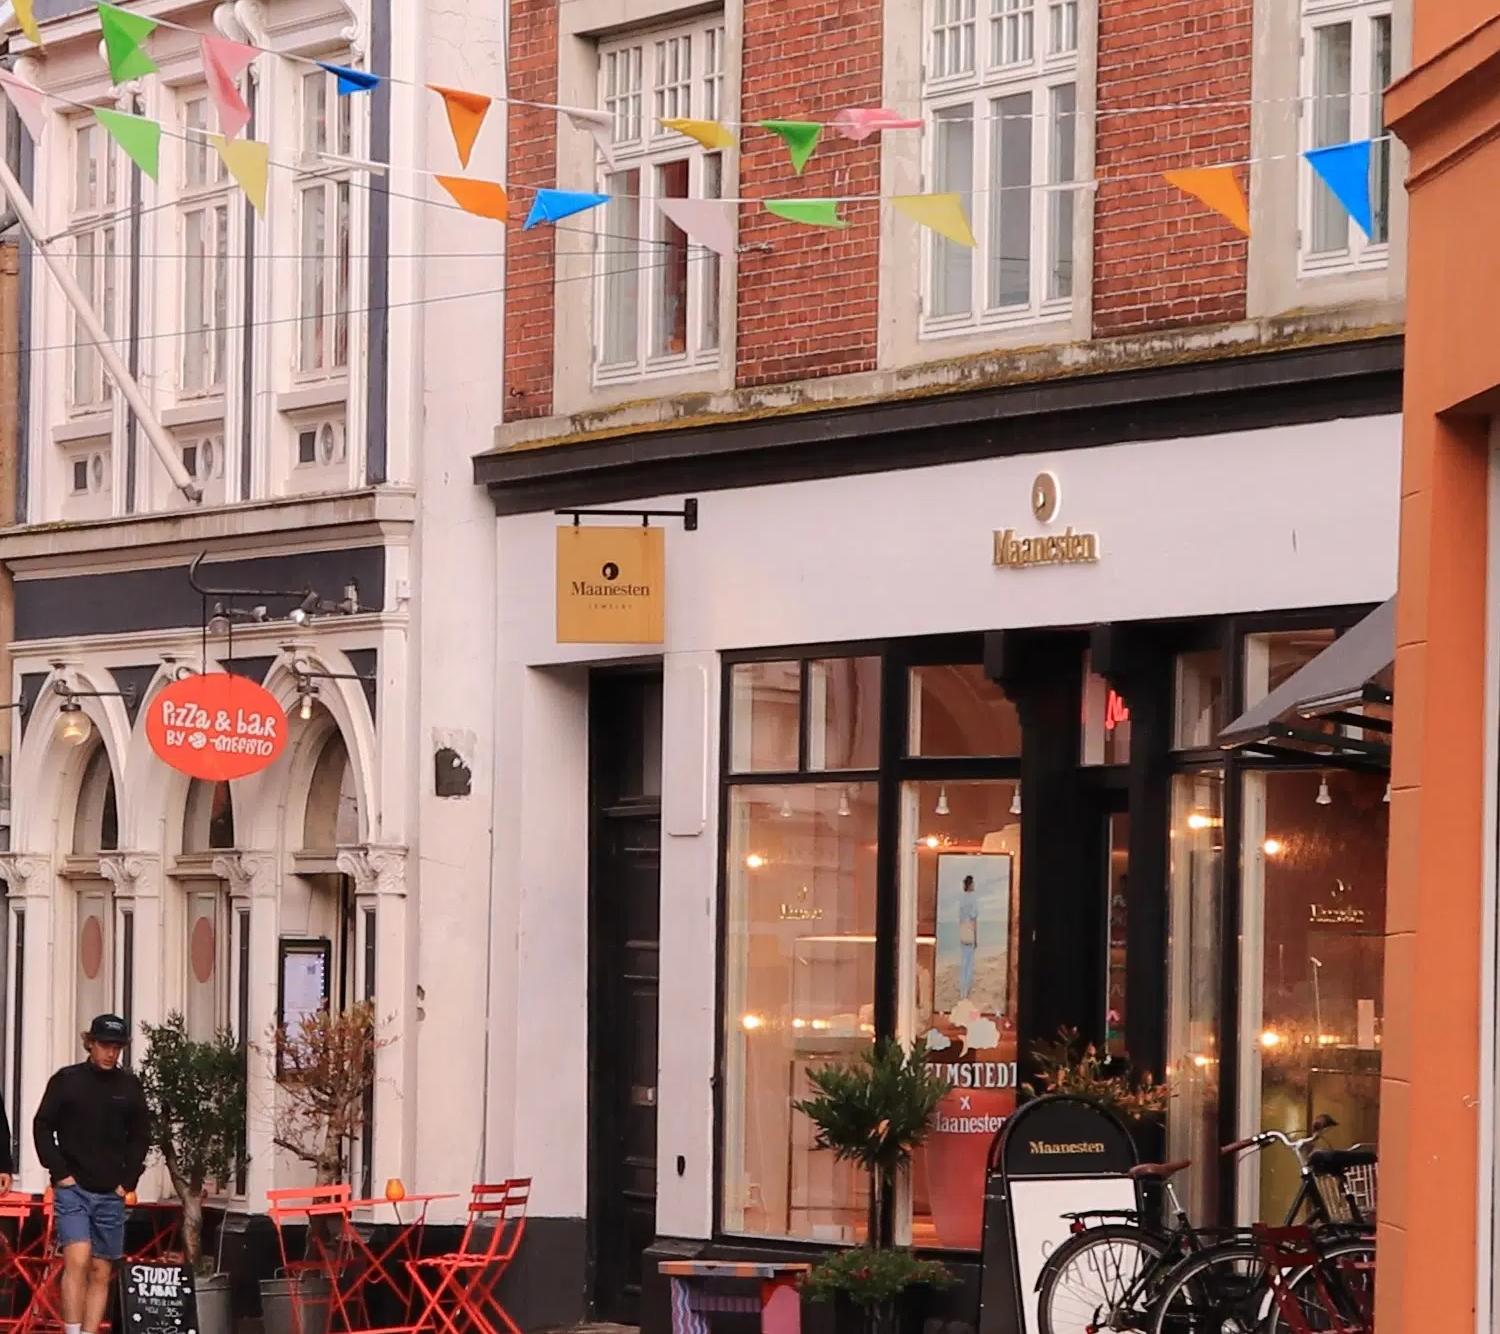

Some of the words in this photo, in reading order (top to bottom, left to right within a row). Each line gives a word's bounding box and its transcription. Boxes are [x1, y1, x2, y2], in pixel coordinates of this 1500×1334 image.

[992, 526, 1099, 566] Maanesten
[571, 581, 650, 596] Maanesten
[215, 710, 231, 731] &
[166, 729, 186, 746] BY
[1030, 1141, 1104, 1154] Maanesten
